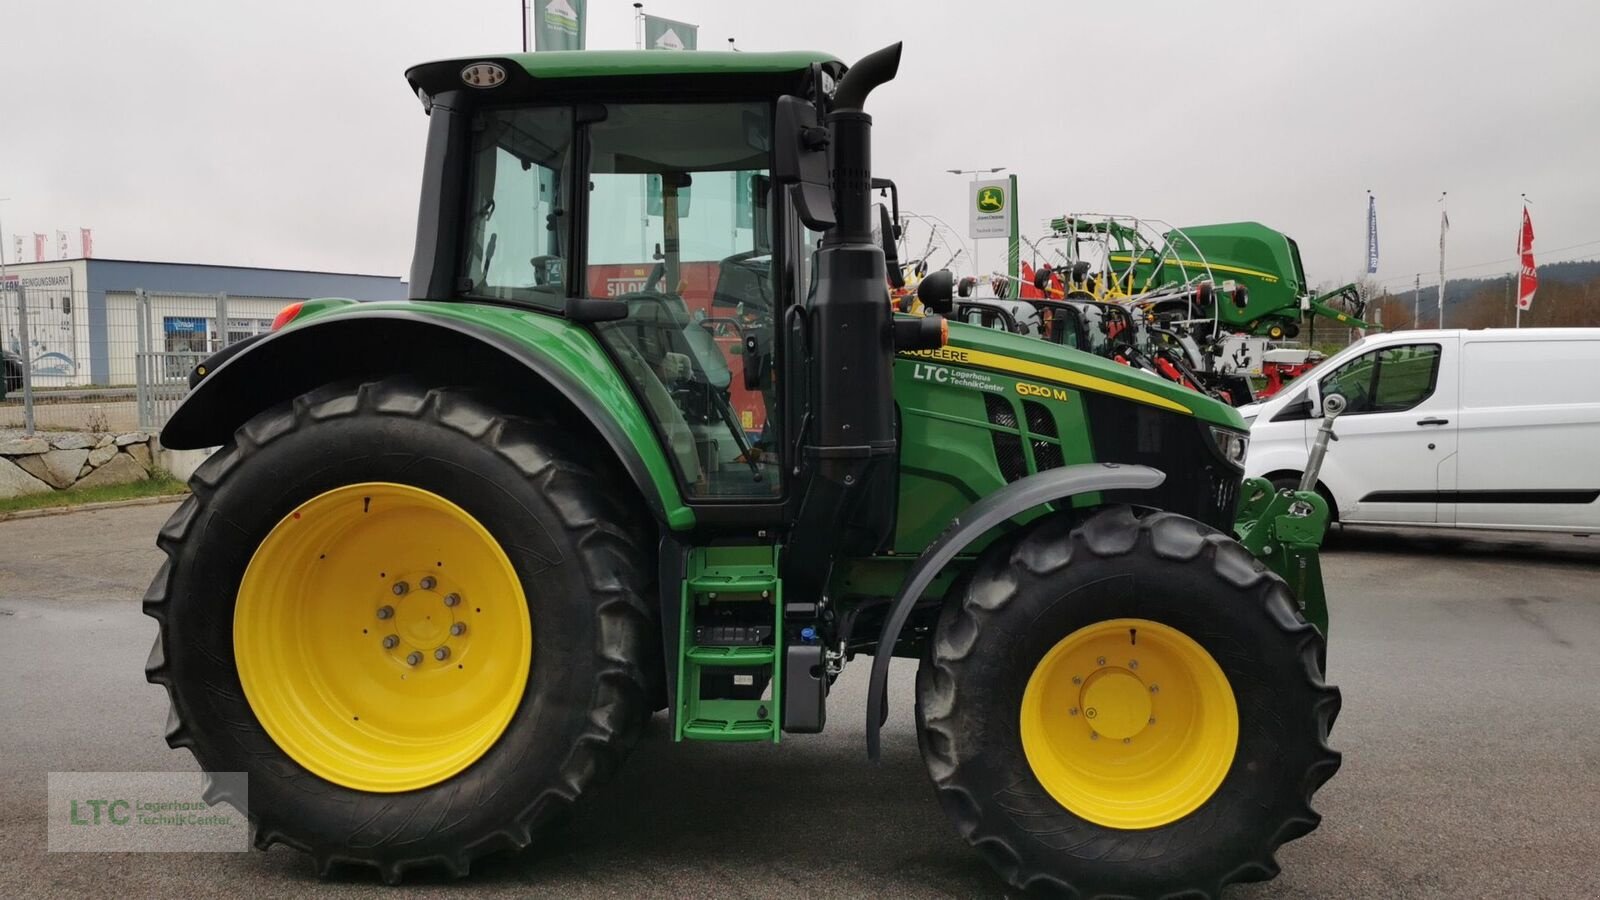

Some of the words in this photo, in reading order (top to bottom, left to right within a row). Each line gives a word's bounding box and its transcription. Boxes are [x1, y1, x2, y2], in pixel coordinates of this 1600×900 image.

[922, 348, 969, 362] DEERE
[913, 363, 949, 383] LTC
[951, 369, 991, 381] Lagerhaus
[950, 377, 1005, 392] TechnikCenter
[1015, 382, 1051, 398] 6120
[1053, 388, 1068, 401] M
